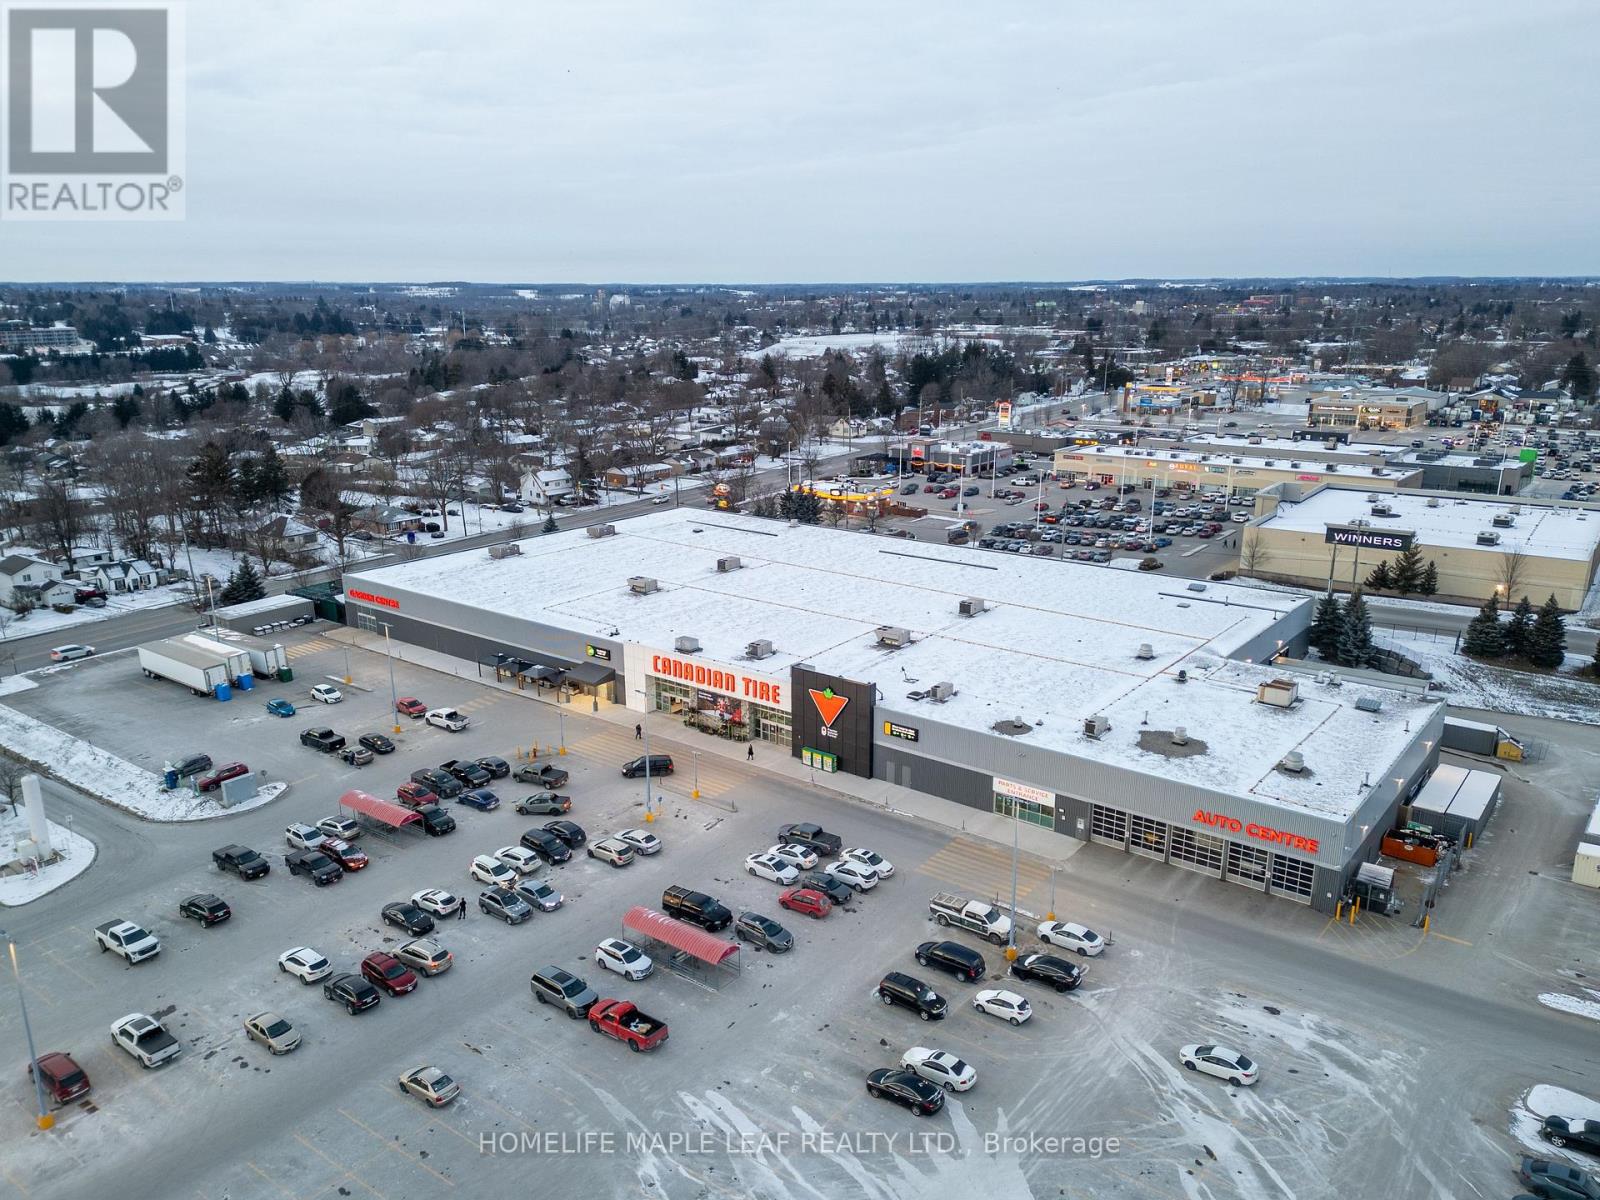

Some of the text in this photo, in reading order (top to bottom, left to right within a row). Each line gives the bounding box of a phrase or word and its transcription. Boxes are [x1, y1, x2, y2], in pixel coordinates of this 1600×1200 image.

[1334, 532, 1402, 547] WINNERS
[652, 655, 781, 704] CANADIAN TIRE
[1193, 809, 1319, 854] AUTO CENTRE
